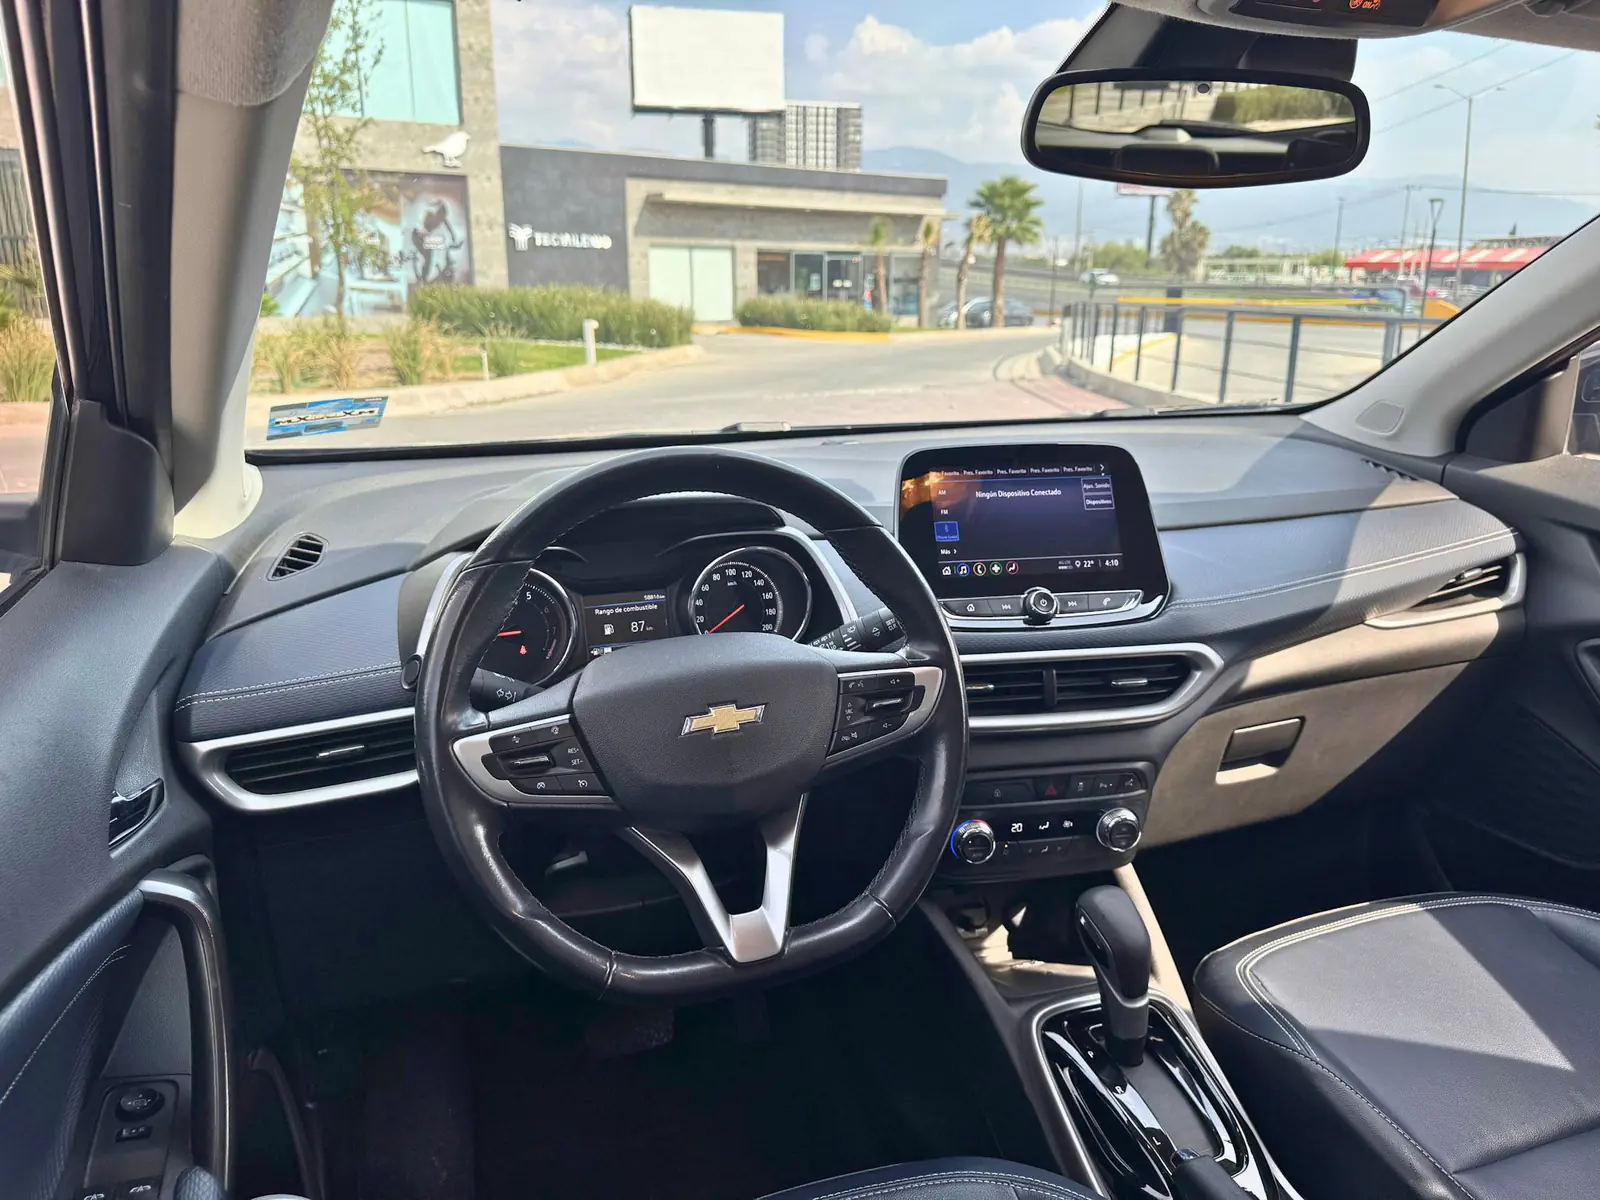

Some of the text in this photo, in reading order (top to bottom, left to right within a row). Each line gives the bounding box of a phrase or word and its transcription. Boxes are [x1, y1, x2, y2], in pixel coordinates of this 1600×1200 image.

[976, 490, 997, 499] Ningún
[998, 490, 1030, 498] Dispositivo
[623, 604, 658, 612] combustible
[631, 621, 645, 632] 87
[1011, 823, 1023, 832] 20
[1115, 1086, 1124, 1094] R
[1152, 1136, 1160, 1145] L
